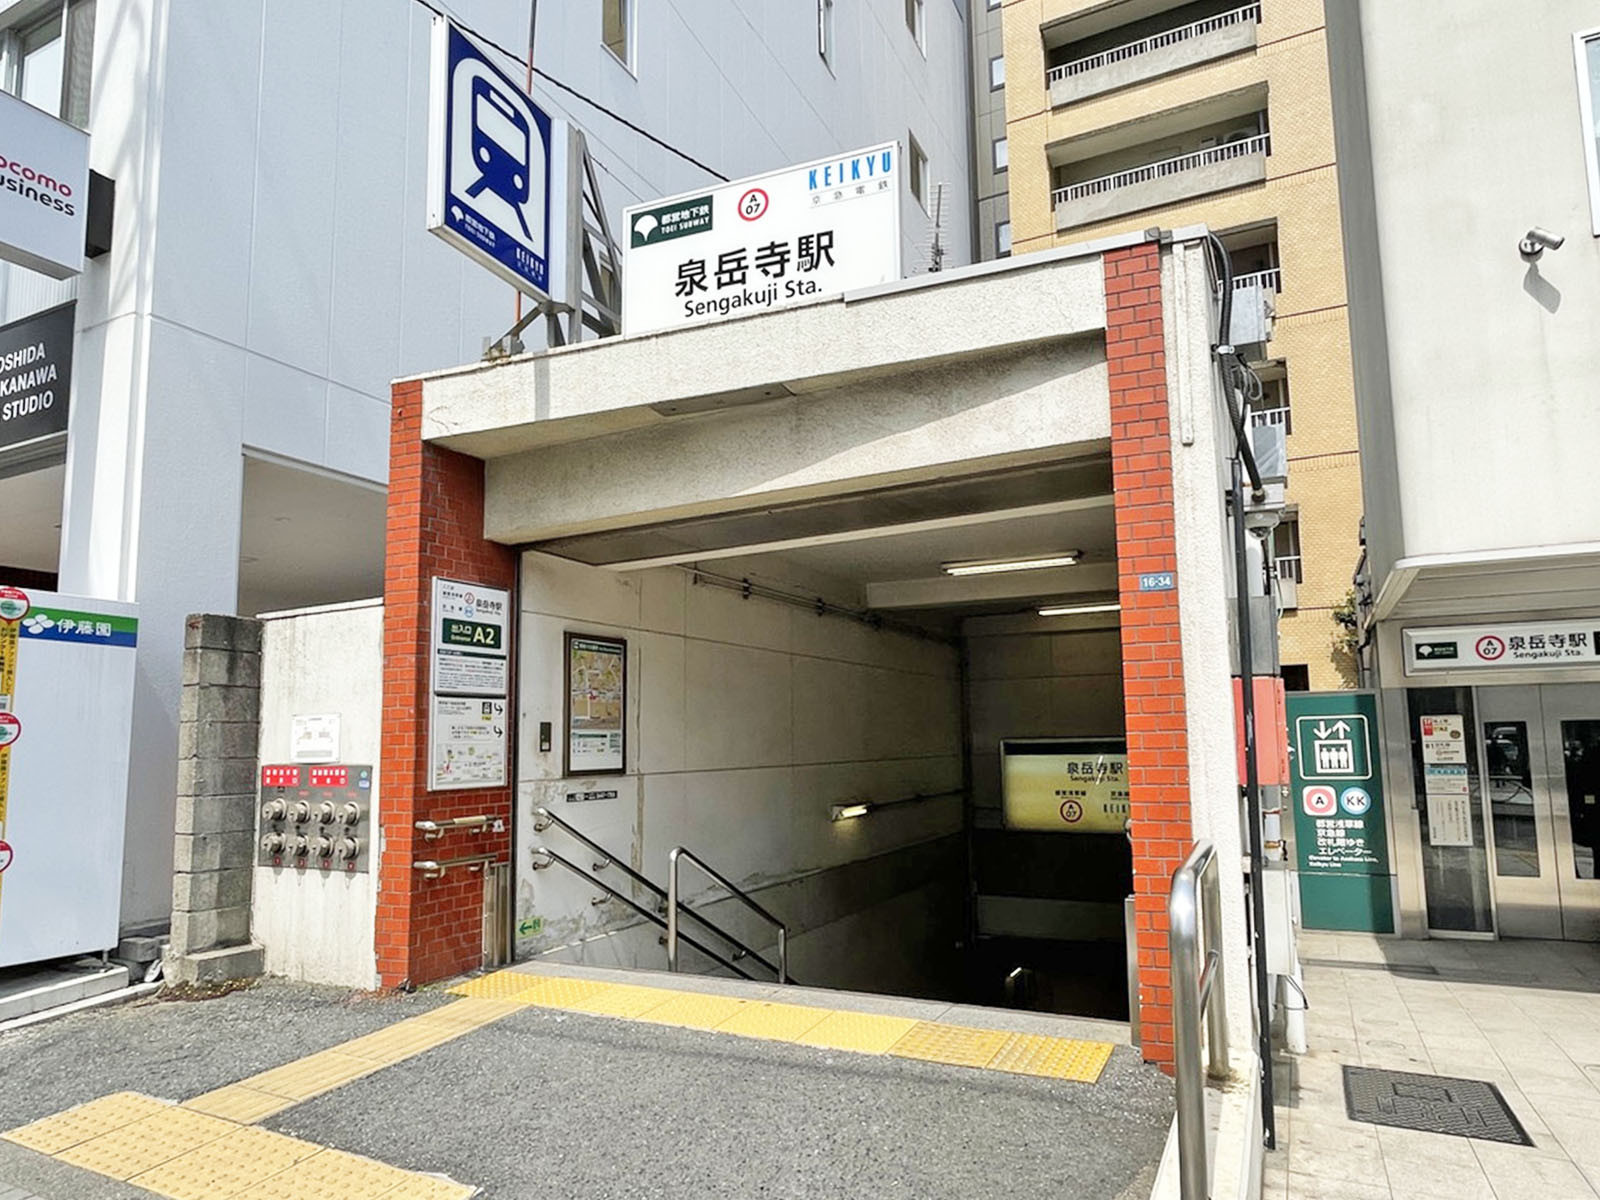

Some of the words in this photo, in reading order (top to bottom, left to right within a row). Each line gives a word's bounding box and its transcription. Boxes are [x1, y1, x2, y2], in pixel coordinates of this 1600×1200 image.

[809, 151, 891, 190] KEIKYU
[749, 194, 757, 203] A
[745, 203, 761, 215] 07
[661, 224, 678, 234] TOEI
[679, 216, 710, 230] SUBWAY
[675, 230, 835, 298] 泉岳寺駅
[684, 283, 778, 317] Sengakuji
[785, 279, 823, 298] Sta.
[2, 390, 54, 421] STUDIO
[1143, 576, 1171, 587] 16-34
[57, 618, 111, 636] 伊藤園
[473, 626, 495, 645] A2
[1508, 632, 1587, 650] 泉岳寺駅
[1483, 647, 1497, 656] 07
[1513, 650, 1562, 659] Sengakuji
[1315, 796, 1325, 805] A
[1346, 795, 1366, 806] KK
[1318, 847, 1373, 856] エレベーター
